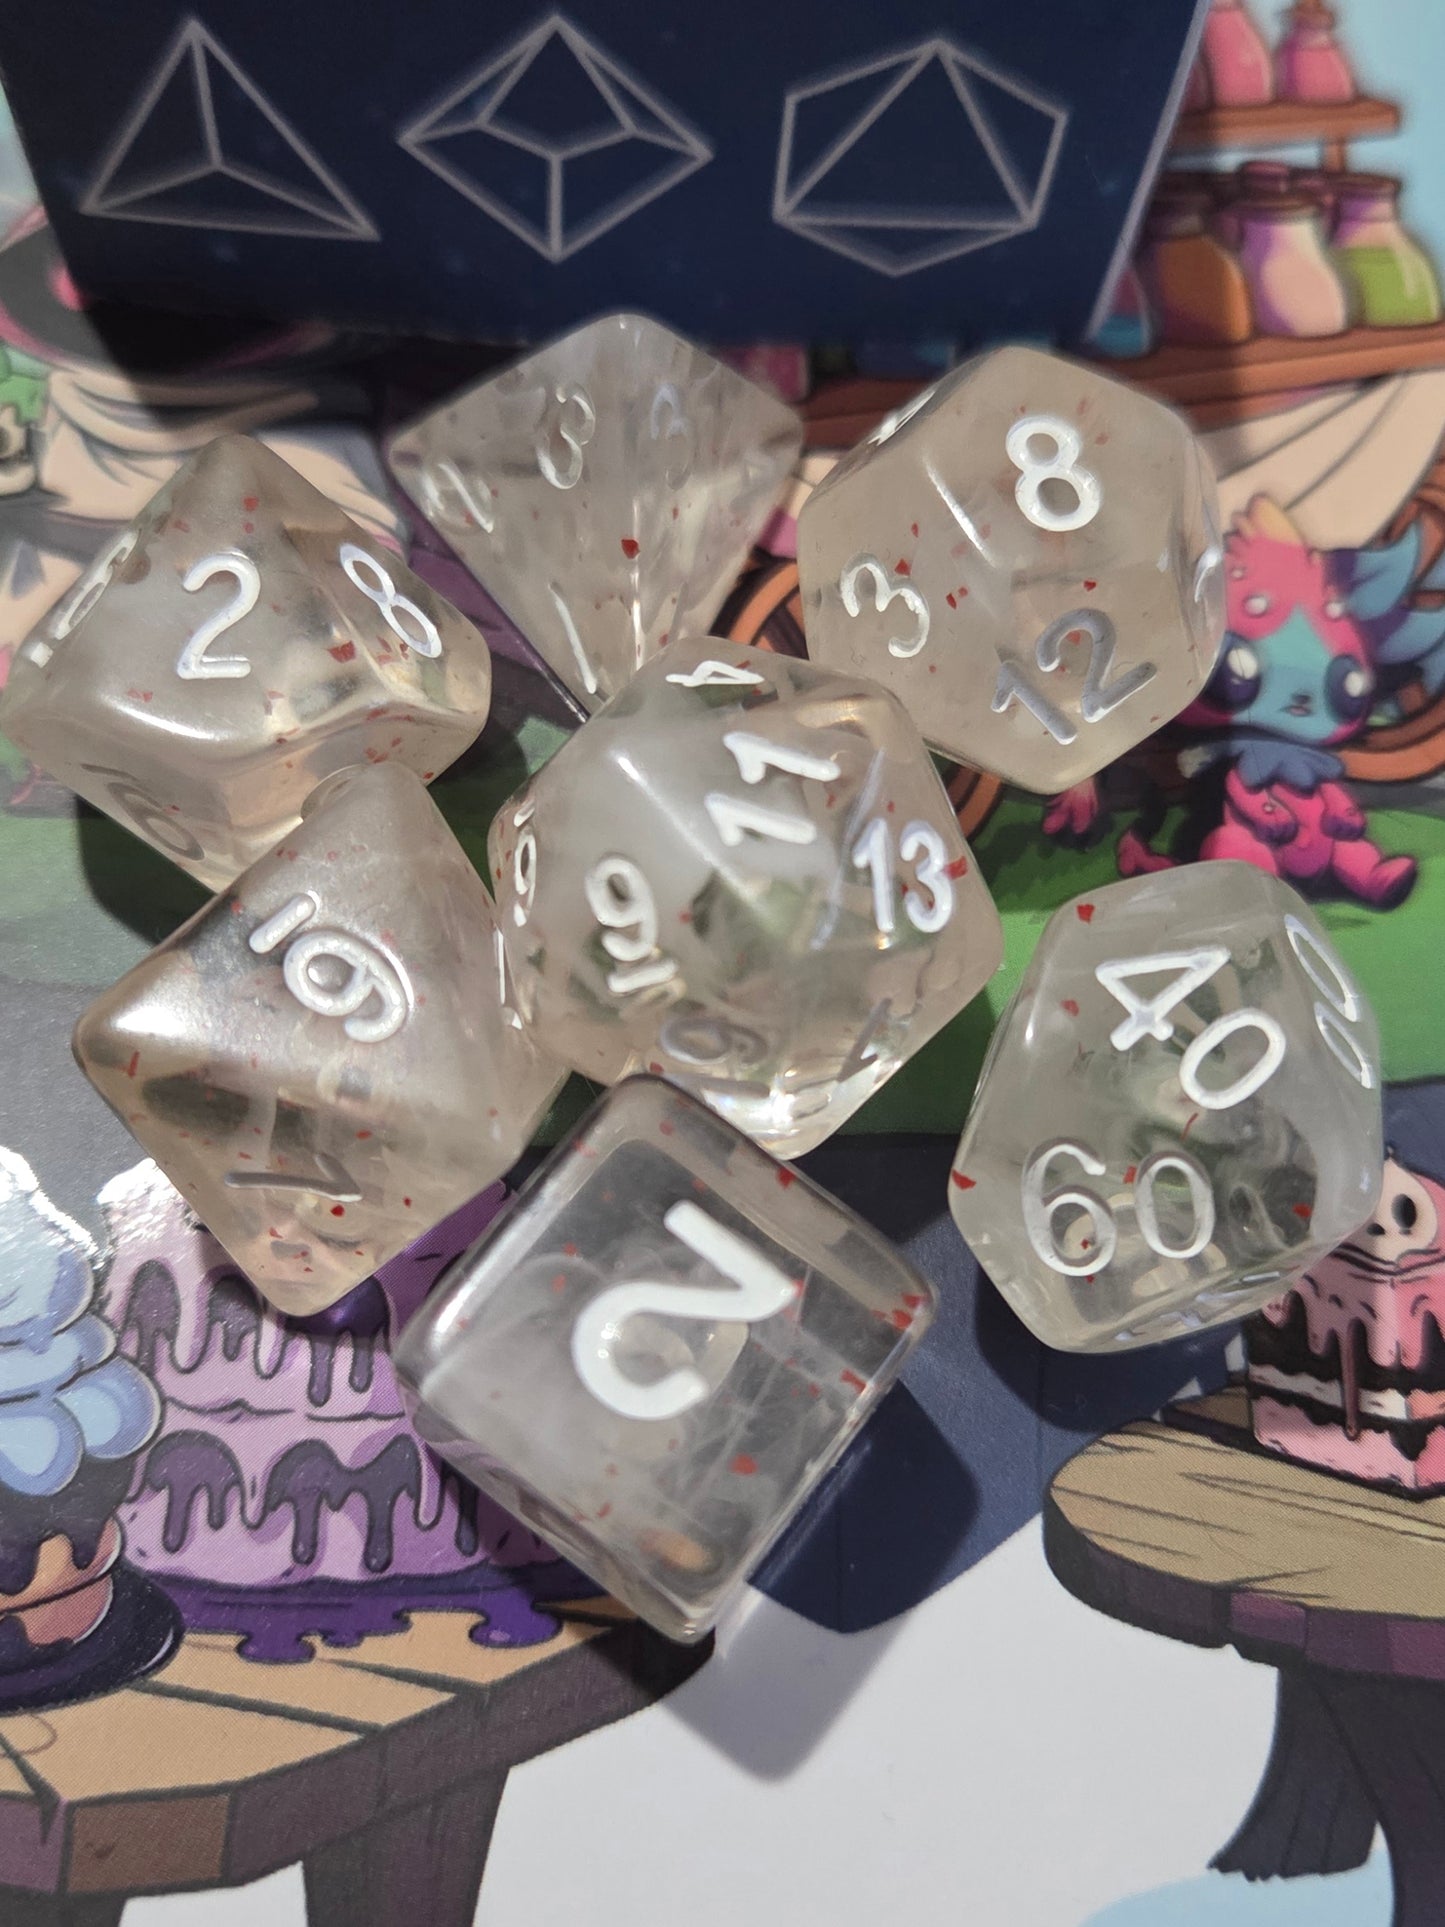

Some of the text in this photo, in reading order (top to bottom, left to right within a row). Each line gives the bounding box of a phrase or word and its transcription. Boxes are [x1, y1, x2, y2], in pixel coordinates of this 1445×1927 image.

[1006, 416, 1101, 532] 8
[176, 550, 261, 680] 2
[339, 543, 442, 658] 8
[840, 554, 930, 658] 3
[991, 608, 1157, 745] 12
[704, 731, 841, 846] 11
[853, 818, 955, 933] 13
[1095, 946, 1287, 1110] 40
[1021, 1137, 1216, 1277] 60
[570, 1200, 804, 1421] 2
